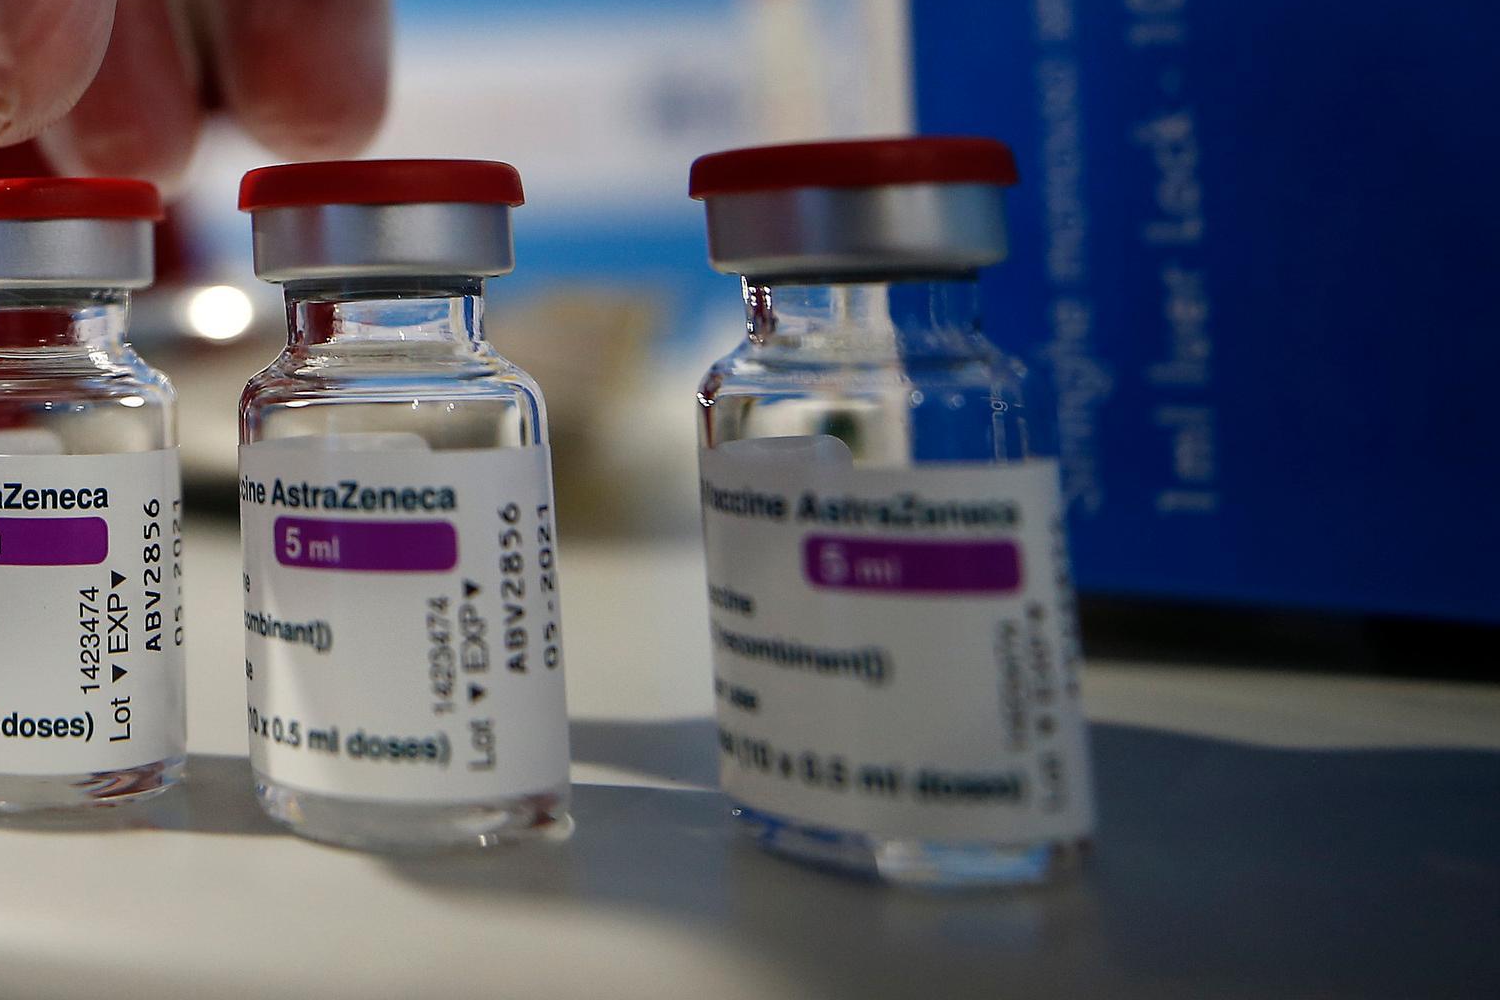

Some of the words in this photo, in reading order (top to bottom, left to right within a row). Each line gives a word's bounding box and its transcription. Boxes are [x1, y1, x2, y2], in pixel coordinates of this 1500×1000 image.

[271, 478, 457, 512] AstraZeneca
[284, 526, 302, 559] 5
[308, 534, 340, 564] ml
[143, 497, 162, 652] ABV2856
[499, 501, 530, 674] ABV2856
[79, 586, 100, 695] 1423474
[107, 592, 129, 654] EXP
[458, 603, 489, 674] EXP
[1, 712, 94, 743] doses)
[109, 695, 131, 743] Lot
[272, 715, 302, 747] 0.5
[306, 726, 340, 754] ml
[346, 731, 452, 769] doses)
